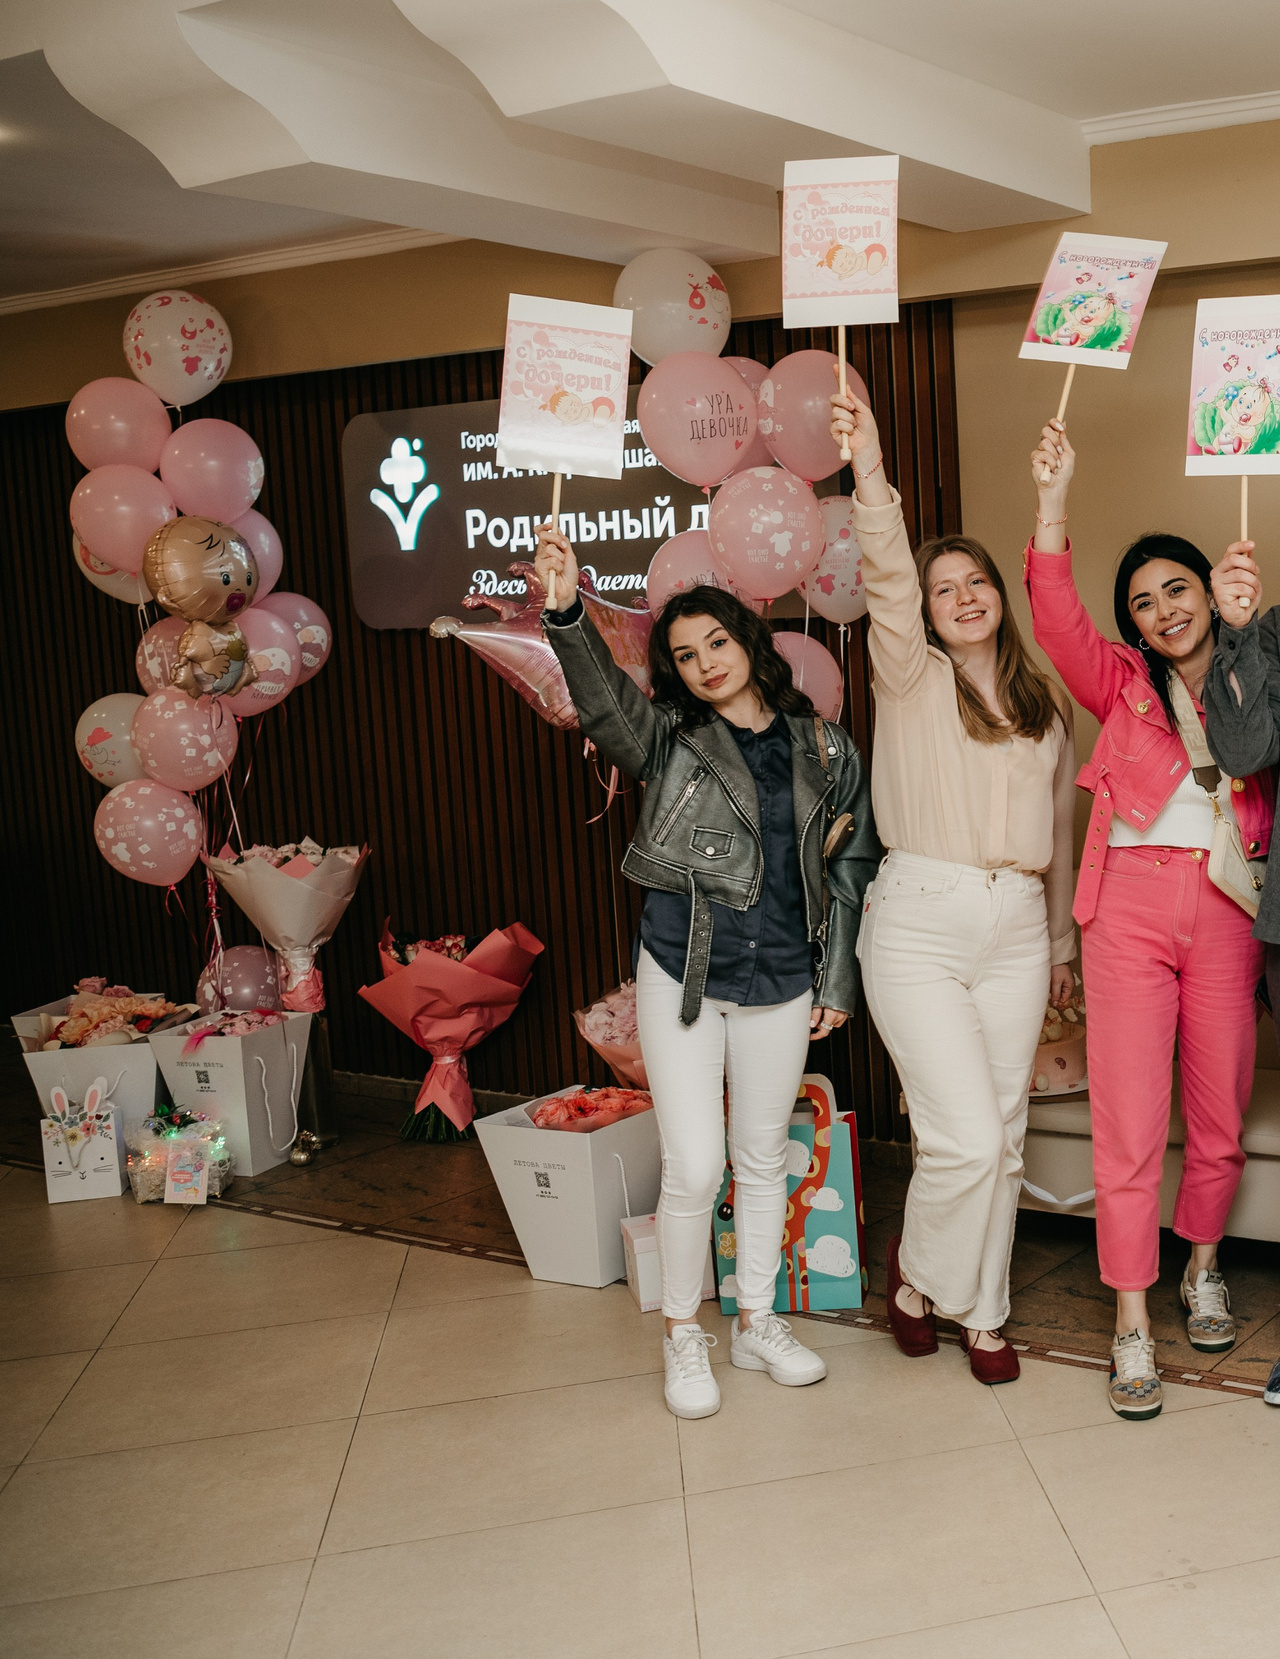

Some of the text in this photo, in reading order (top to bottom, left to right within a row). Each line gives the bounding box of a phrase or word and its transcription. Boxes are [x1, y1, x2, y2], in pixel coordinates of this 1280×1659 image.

[811, 203, 890, 220] рождением
[801, 220, 882, 243] дочери!
[1069, 254, 1157, 270] новорожденной!
[536, 347, 622, 373] рождением
[524, 363, 612, 392] дочери!
[705, 393, 734, 415] УРА
[690, 416, 748, 441] ДЕВОЧКА
[469, 569, 528, 596] Здесь
